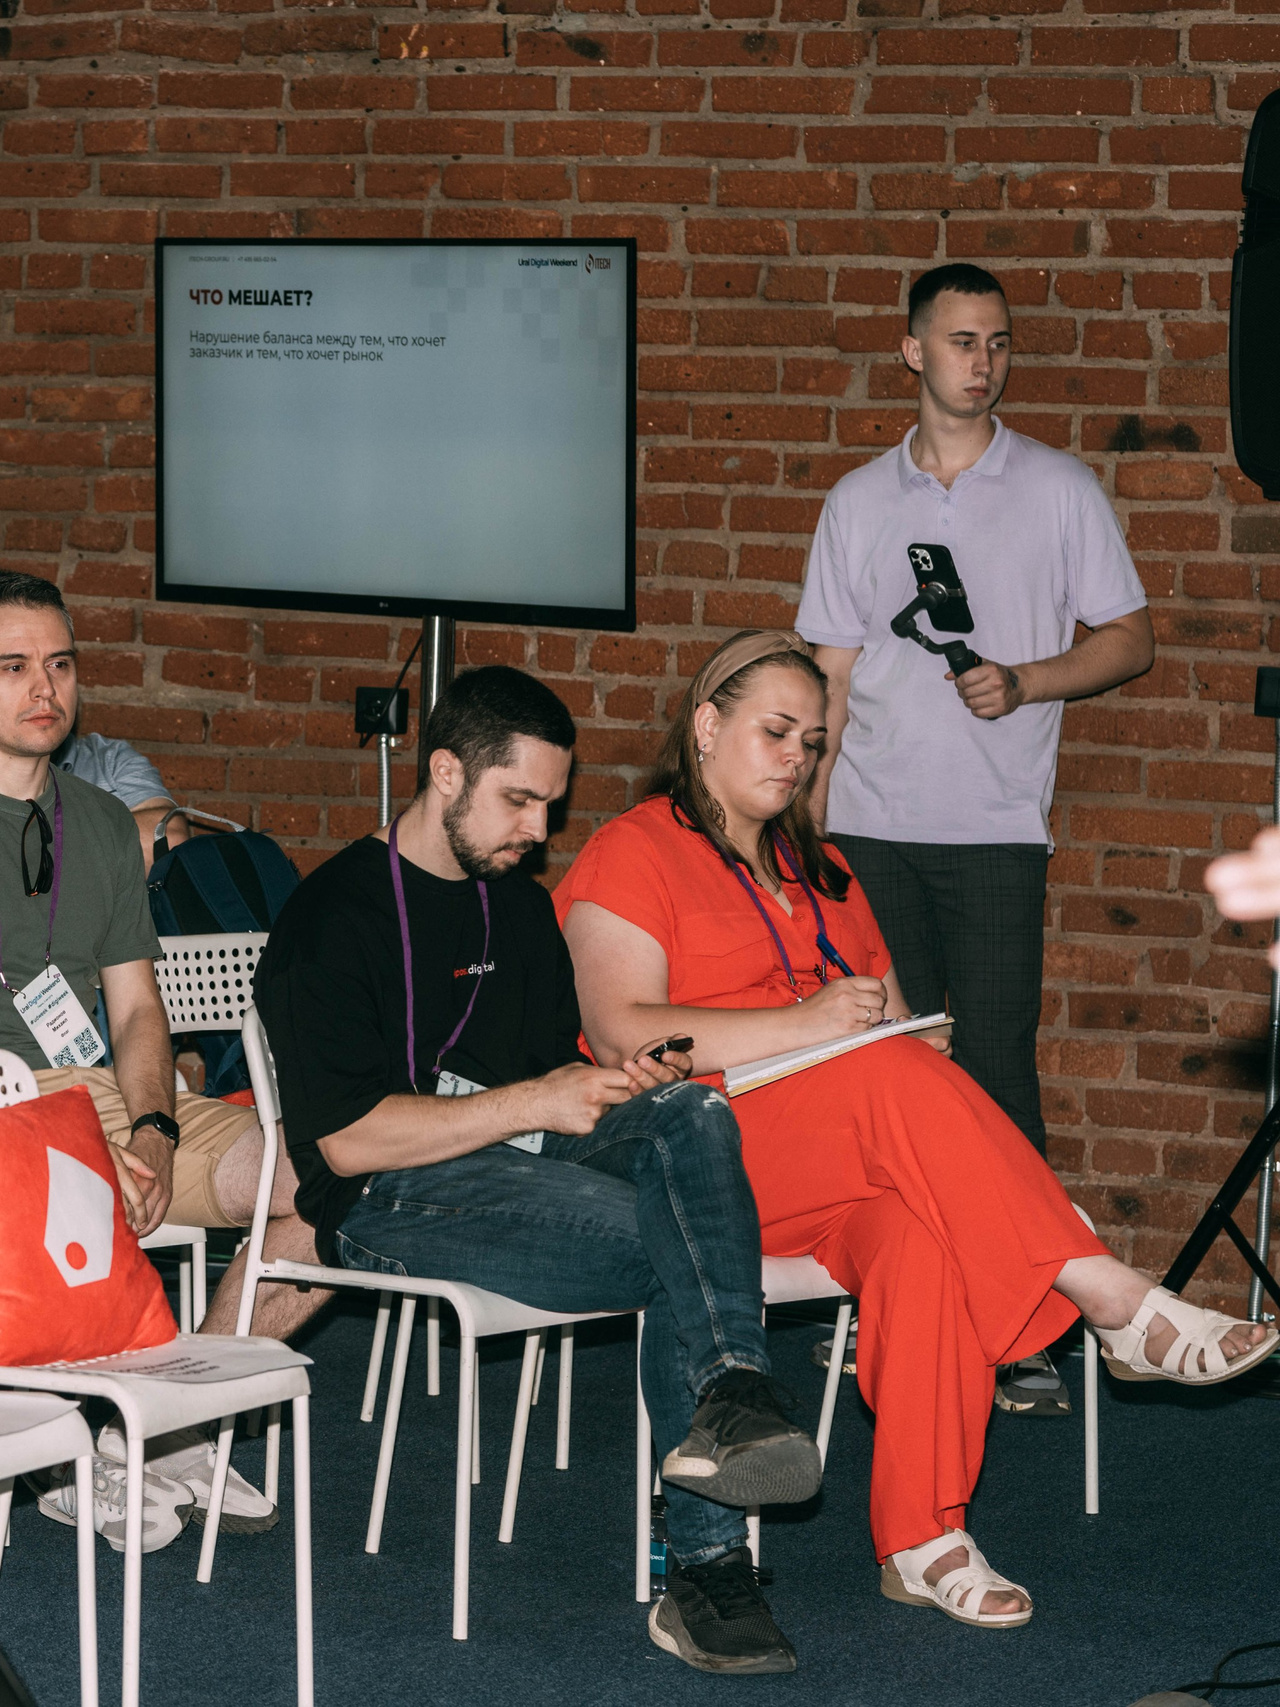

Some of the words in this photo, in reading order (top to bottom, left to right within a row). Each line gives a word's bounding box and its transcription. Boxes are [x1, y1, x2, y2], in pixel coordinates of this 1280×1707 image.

[189, 289, 223, 305] ЧТО
[228, 289, 313, 306] МЕШАЕТ?
[189, 331, 260, 345] Нарушение
[263, 331, 313, 345] баланса
[317, 336, 357, 347] между
[360, 336, 385, 347] тем,
[388, 337, 409, 347] что
[412, 337, 447, 347] хочет
[189, 348, 243, 359] заказчик
[246, 349, 253, 359] и
[257, 350, 281, 361] тем,
[283, 350, 304, 360] что
[306, 350, 340, 361] хочет
[343, 351, 384, 363] рынок
